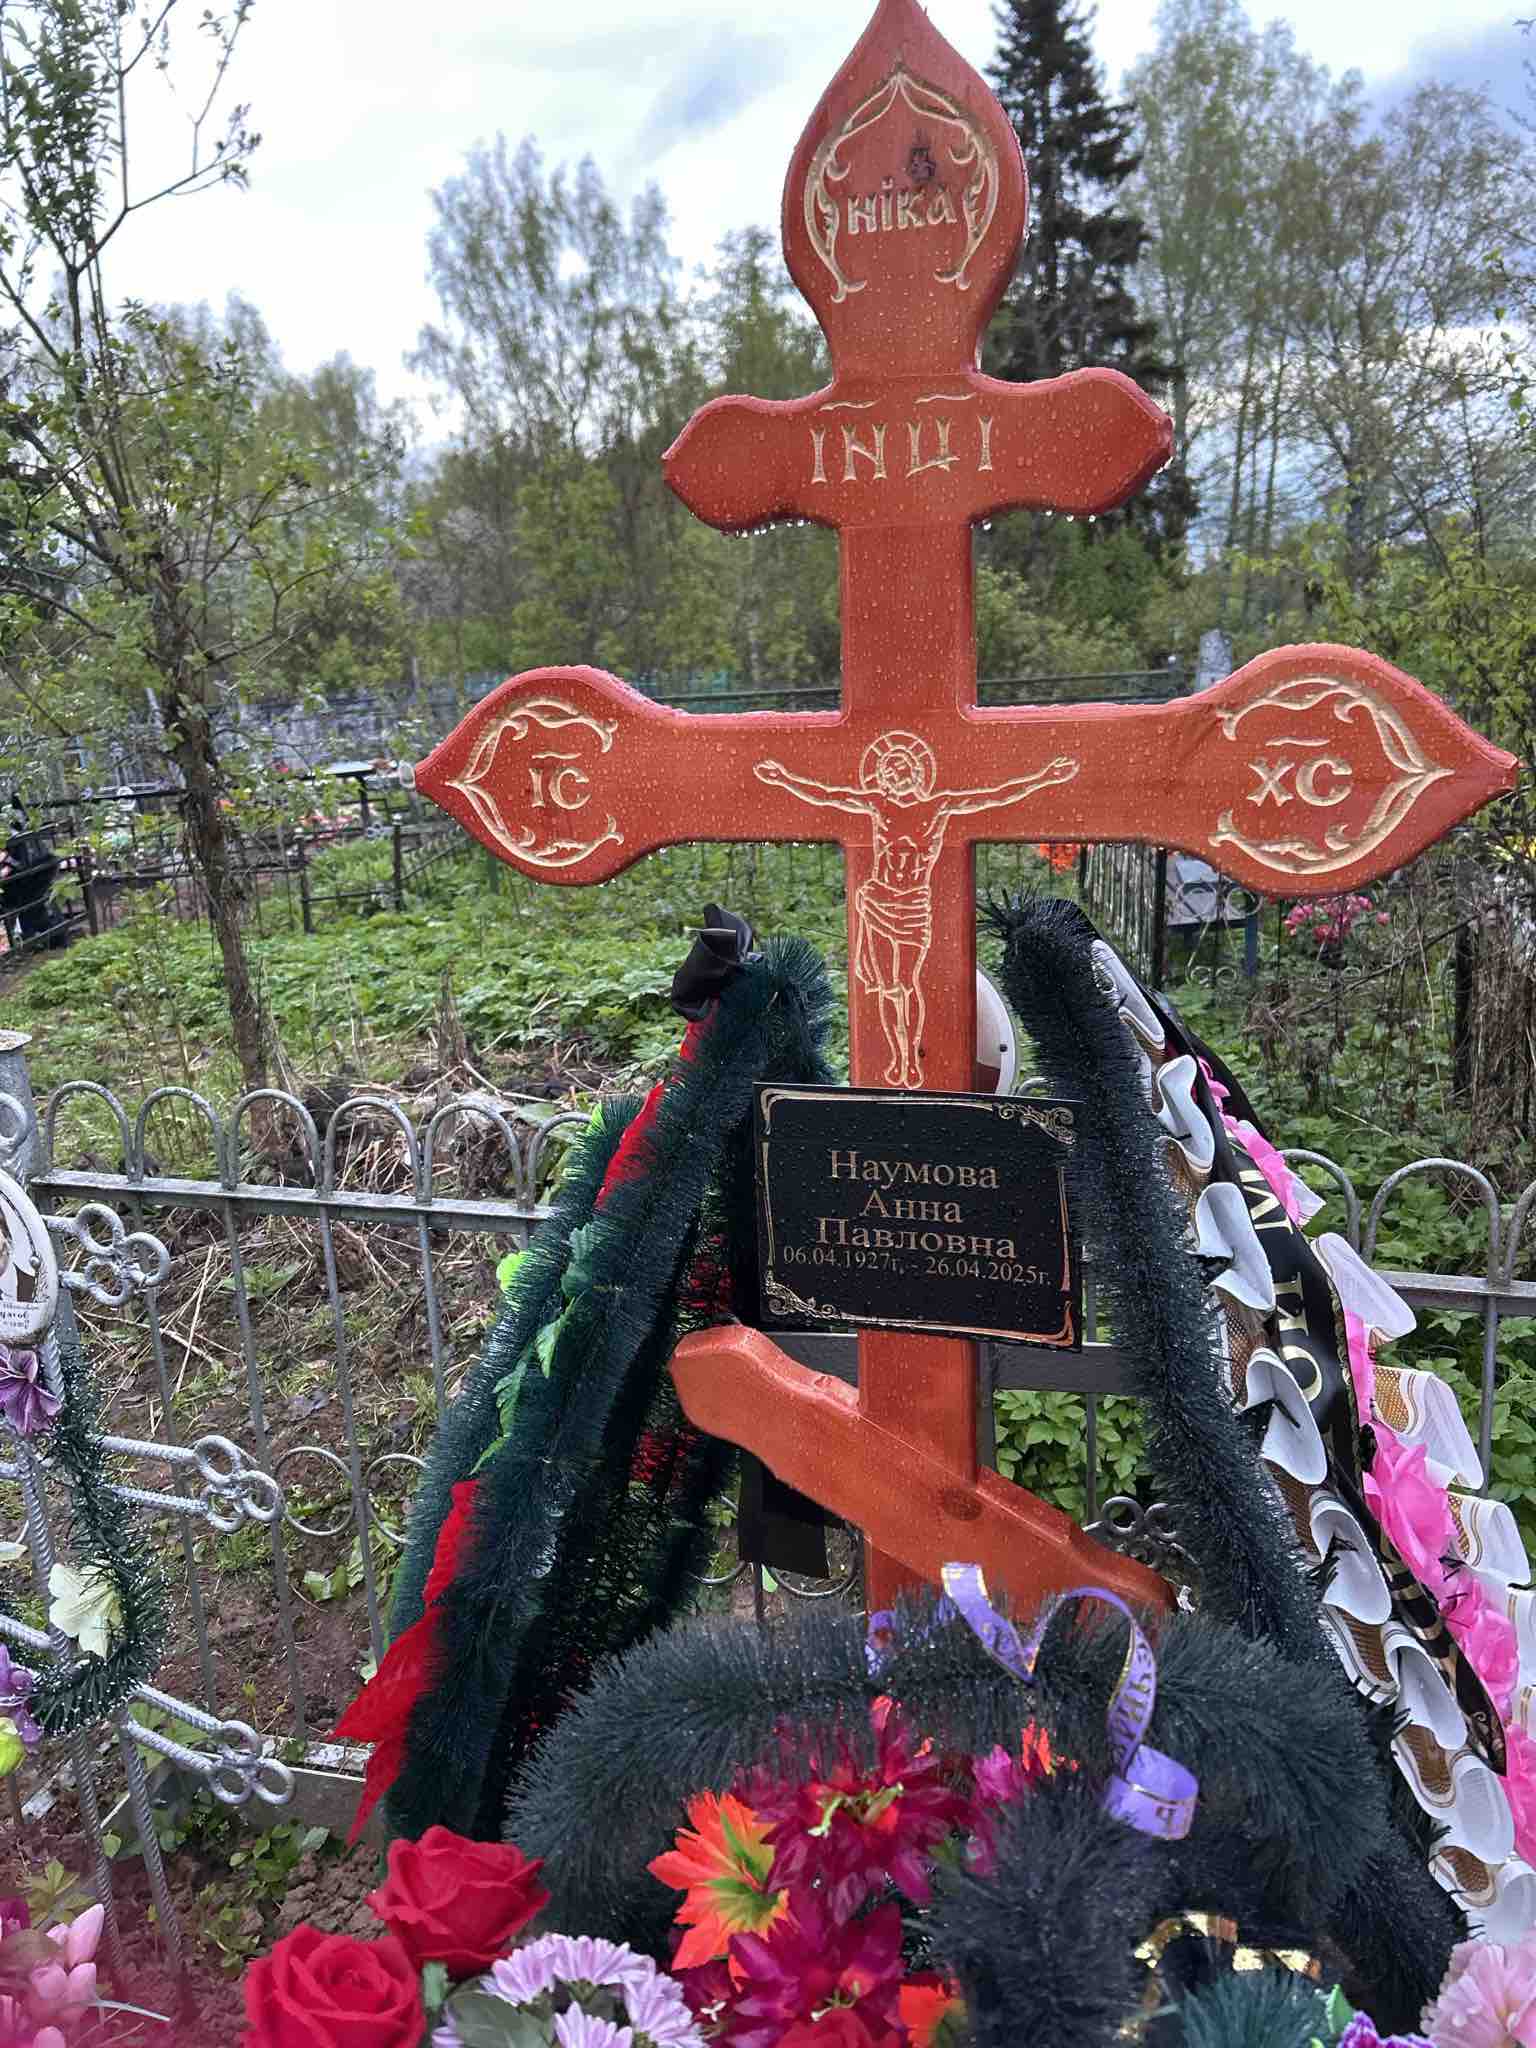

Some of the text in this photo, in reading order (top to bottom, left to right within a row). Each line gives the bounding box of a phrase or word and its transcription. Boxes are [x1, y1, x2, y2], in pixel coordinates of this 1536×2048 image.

[829, 1150, 999, 1190] Наумова
[858, 1189, 963, 1223] Анна
[814, 1216, 1017, 1259] Павловна
[783, 1245, 904, 1274] 06.04.1927г.
[925, 1256, 1052, 1286] 26.04.2025г.
